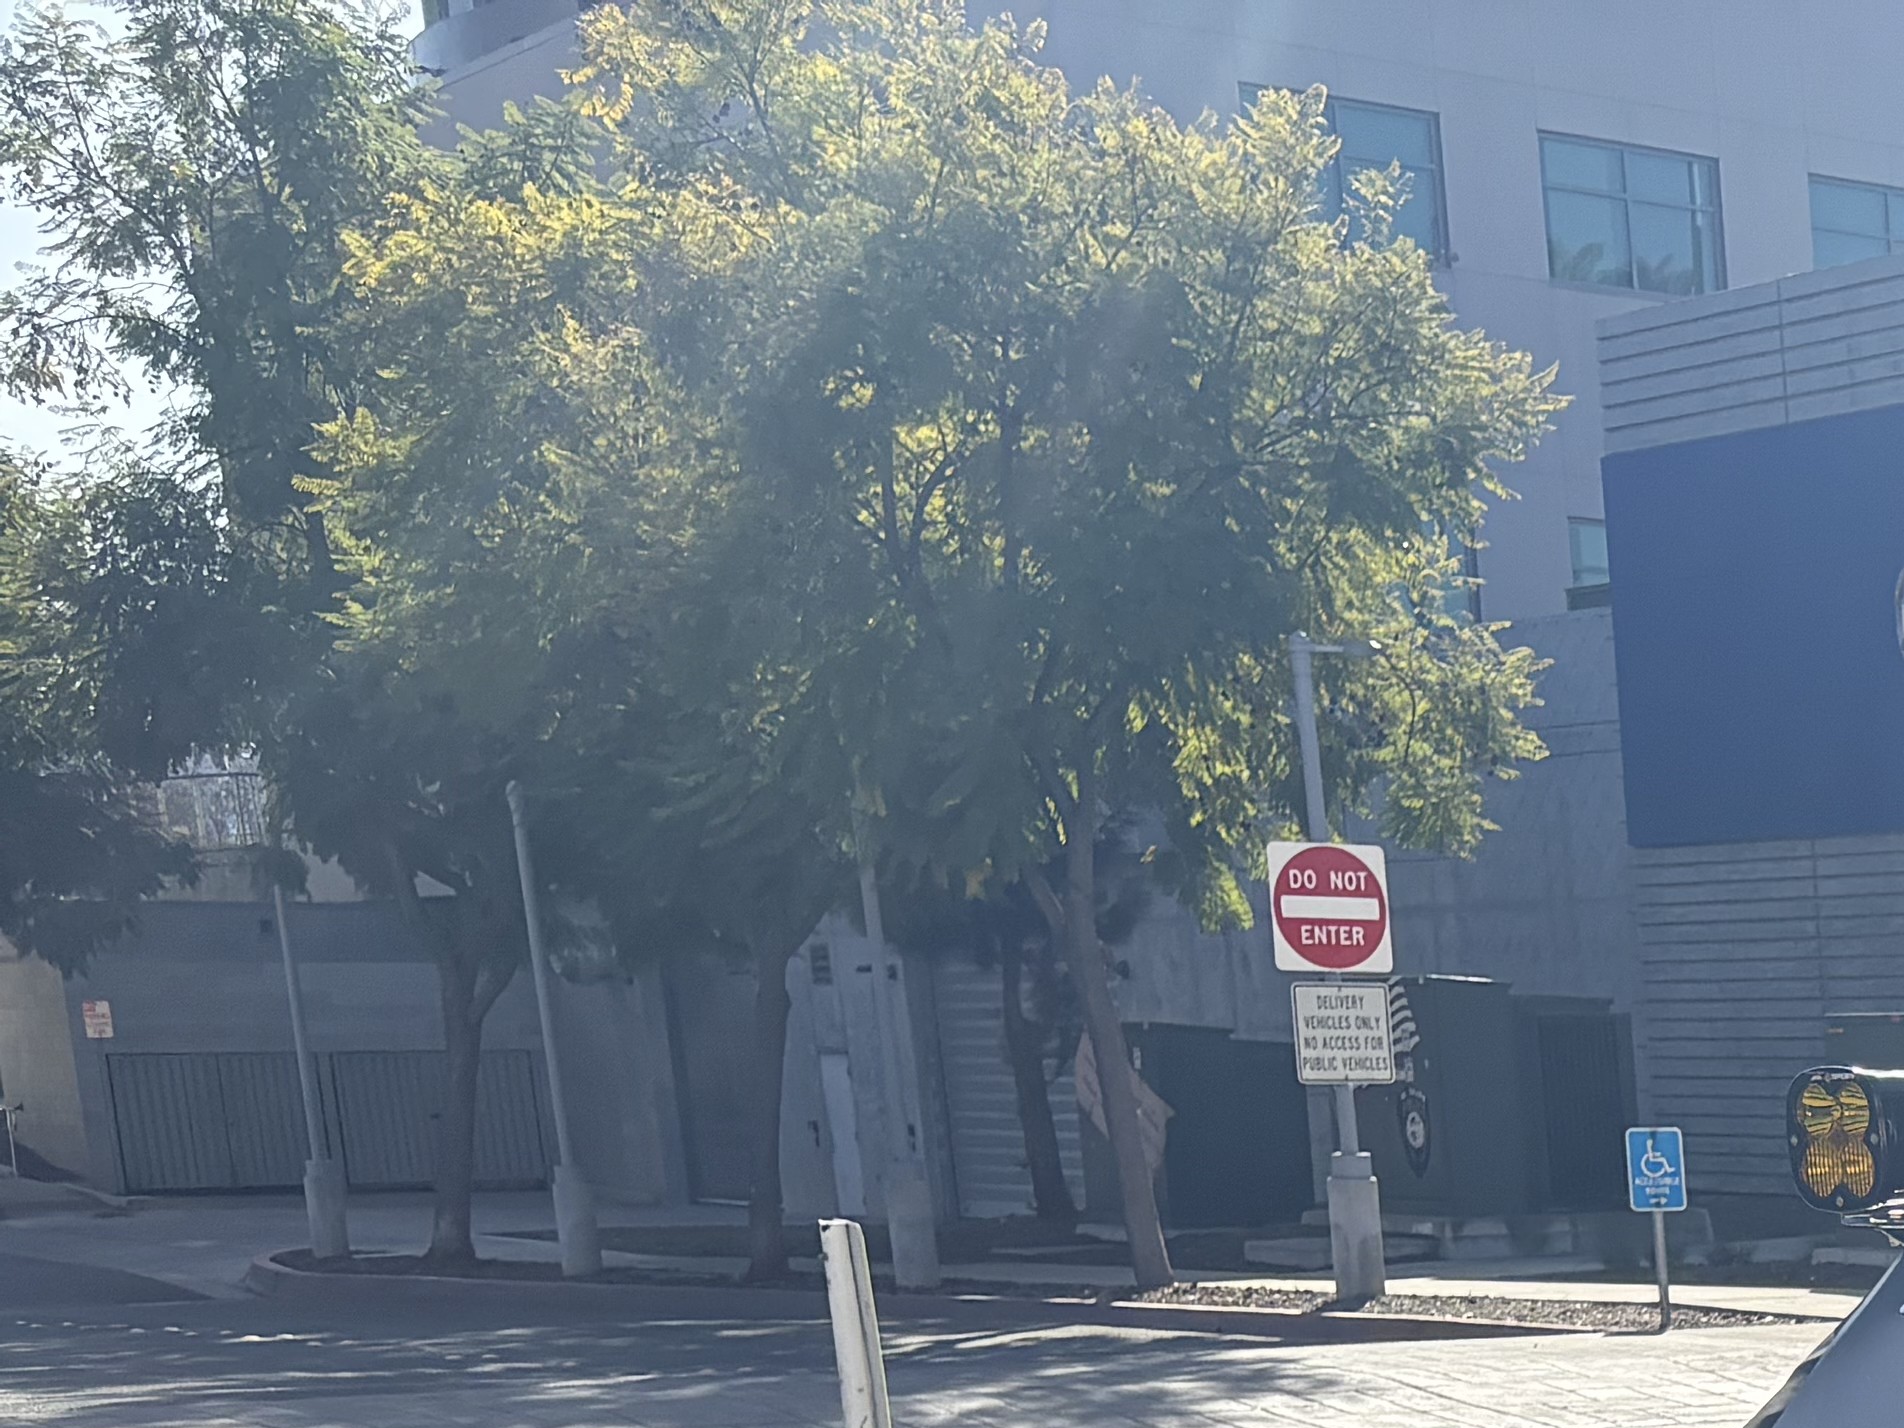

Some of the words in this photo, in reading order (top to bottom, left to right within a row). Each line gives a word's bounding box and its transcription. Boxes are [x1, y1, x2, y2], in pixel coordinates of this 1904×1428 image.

[1288, 868, 1317, 889] DO
[1329, 870, 1368, 892] NOT
[1300, 924, 1365, 946] ENTER
[1316, 994, 1365, 1011] DELIVERY
[1303, 1015, 1352, 1030] VEHICLES
[1354, 1015, 1382, 1031] ONLY
[1304, 1036, 1318, 1051] NO
[1322, 1035, 1360, 1051] ACCESS
[1364, 1035, 1384, 1051] FOR
[1302, 1056, 1338, 1072] PUBLIC
[1341, 1056, 1389, 1072] VEHICLES
